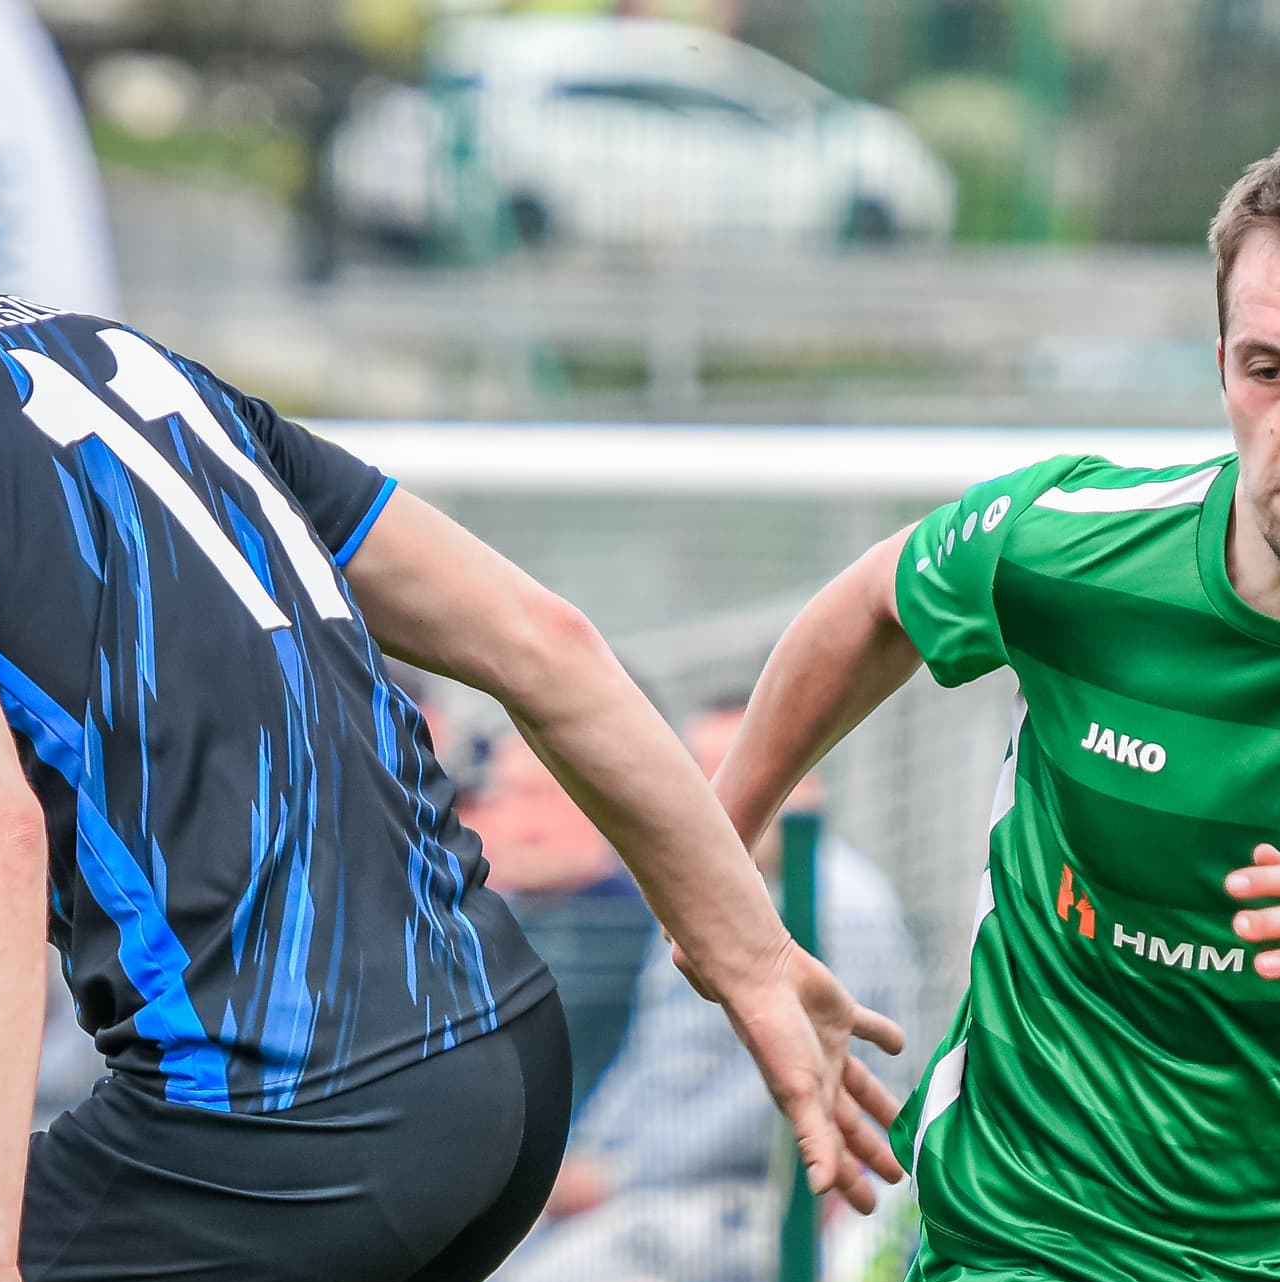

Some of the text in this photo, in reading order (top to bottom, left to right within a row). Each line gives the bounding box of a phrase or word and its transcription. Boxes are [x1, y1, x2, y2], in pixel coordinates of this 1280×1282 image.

[8, 328, 353, 631] 11
[1081, 722, 1167, 773] JAKO
[1113, 922, 1246, 973] HMM
